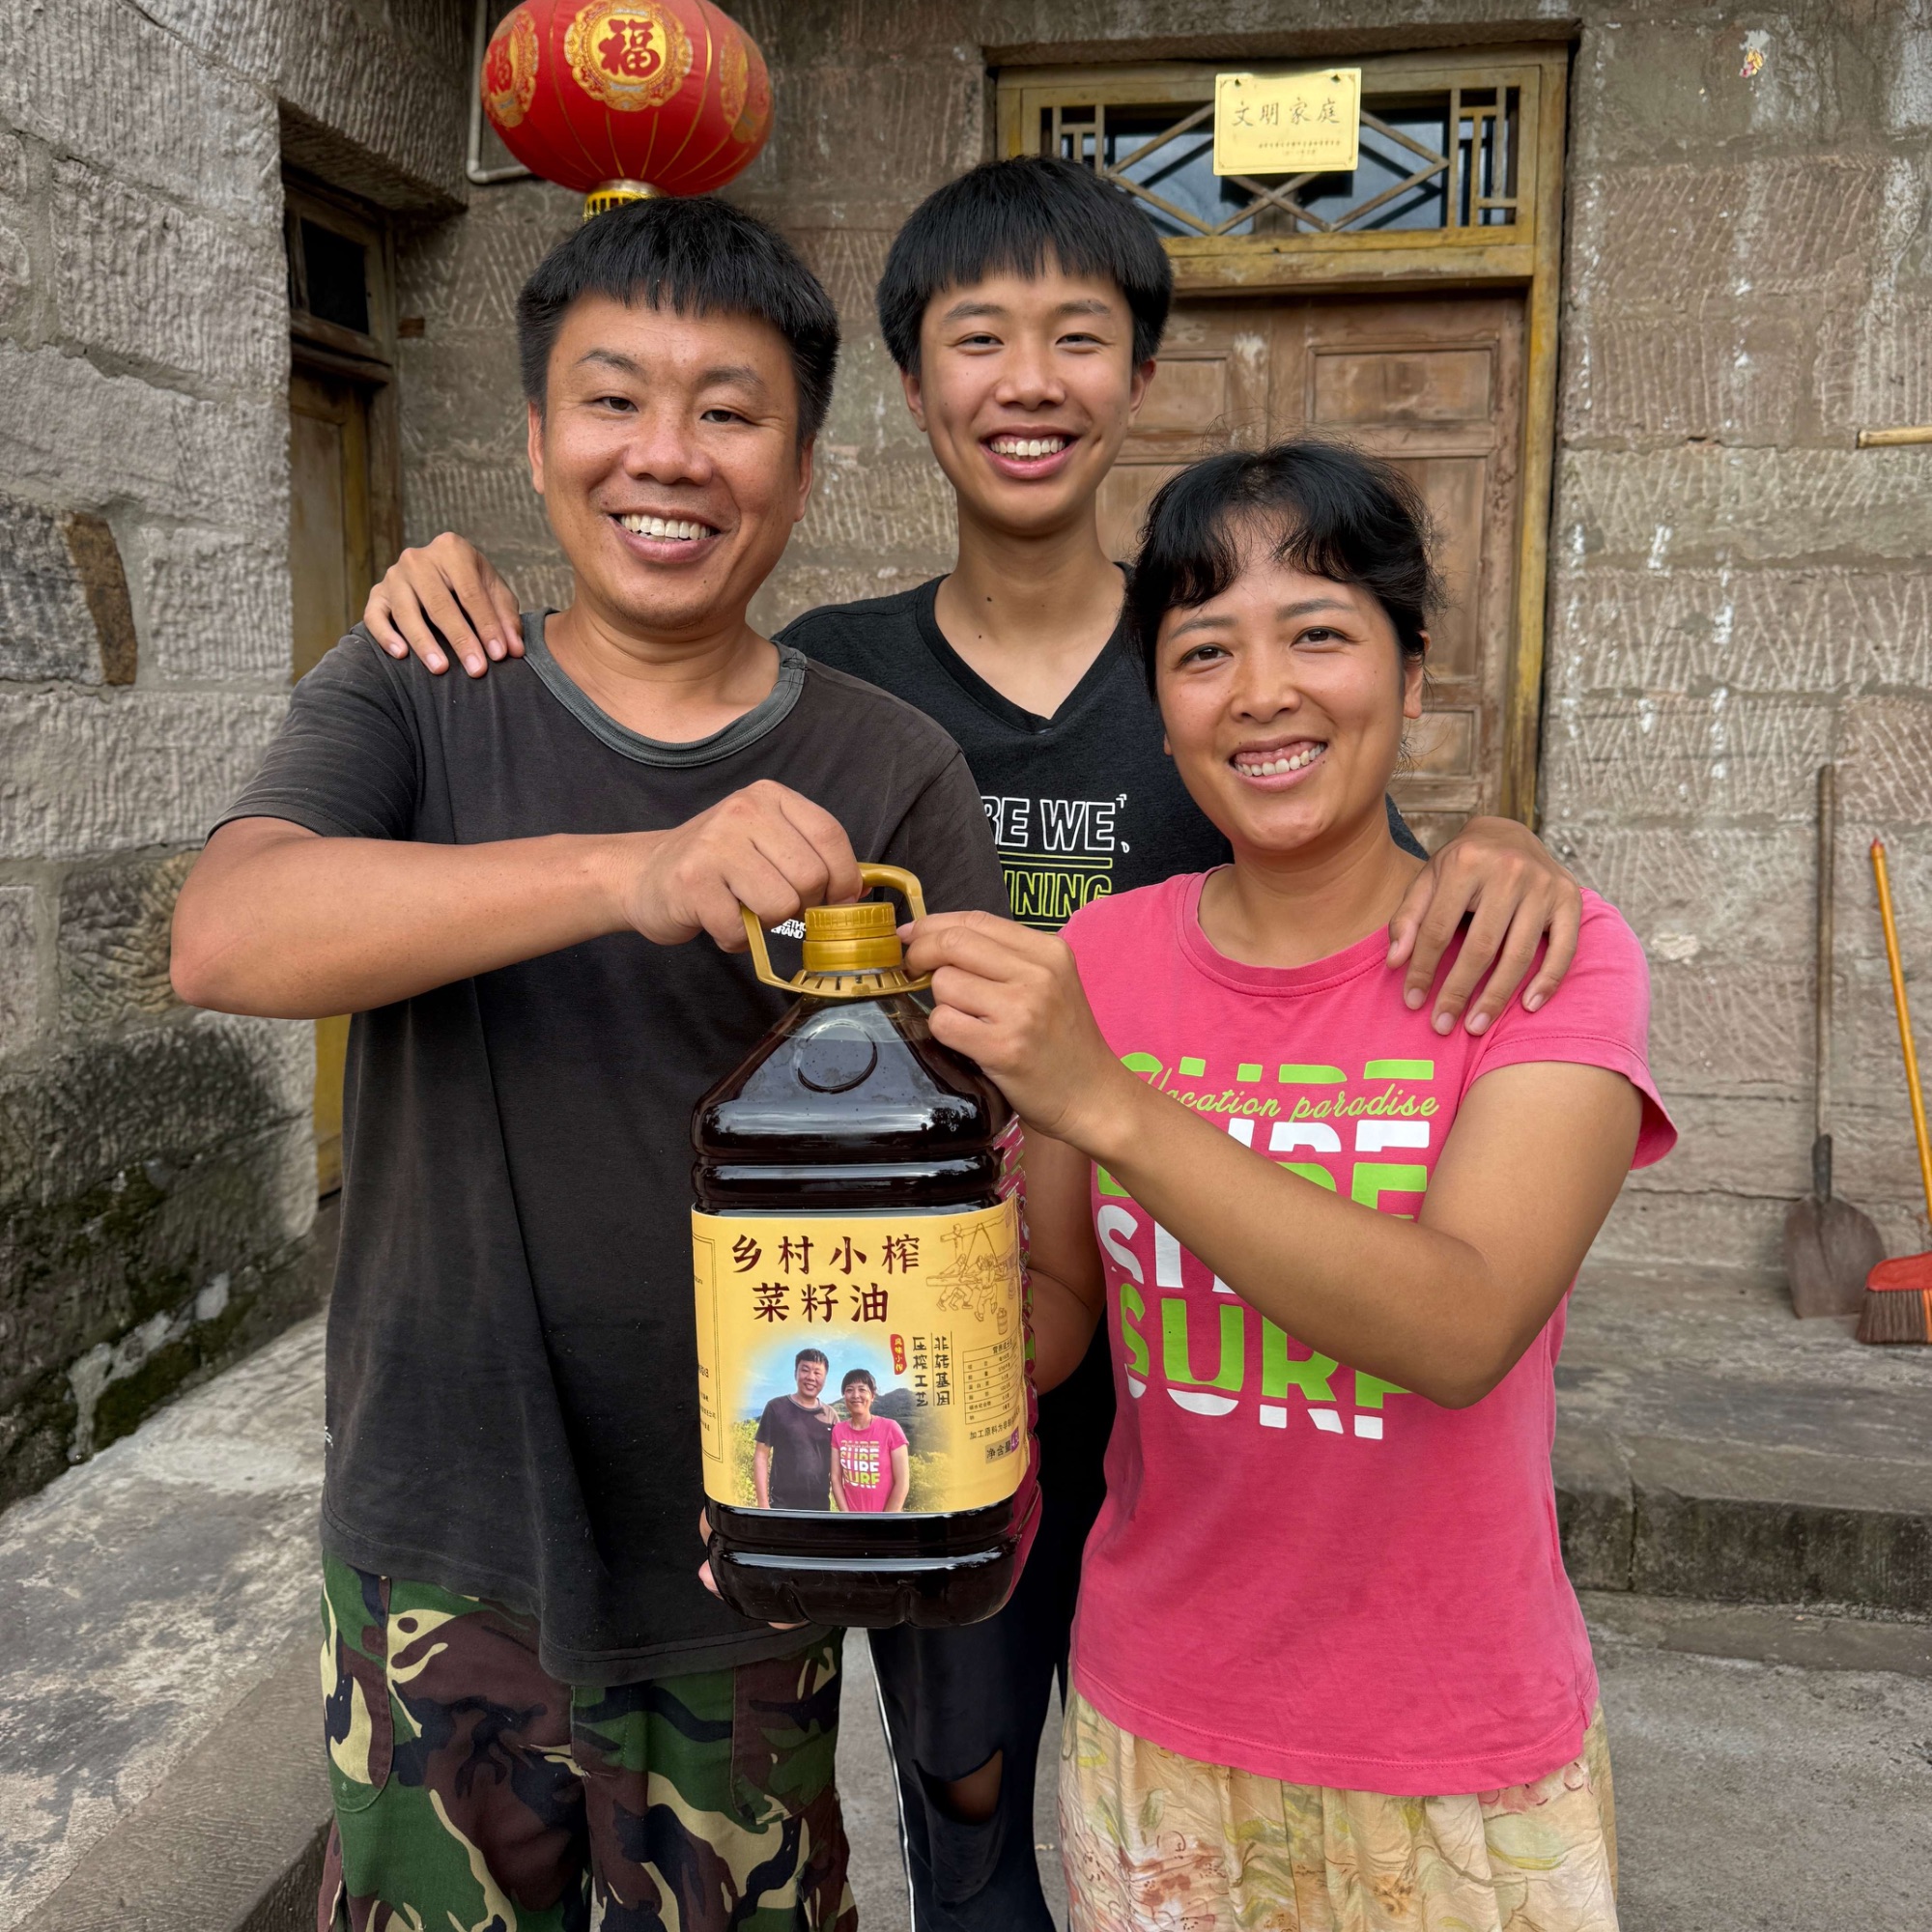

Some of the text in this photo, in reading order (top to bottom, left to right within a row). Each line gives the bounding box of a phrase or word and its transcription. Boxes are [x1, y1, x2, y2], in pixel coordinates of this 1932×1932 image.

[598, 18, 662, 78] 福
[1232, 97, 1341, 128] 文明家庭
[1290, 1083, 1440, 1122] paradise
[731, 1234, 921, 1275] 乡村小榨
[752, 1282, 890, 1323] 菜籽油
[912, 1336, 928, 1407] 压榨工艺
[934, 1335, 951, 1406] 非转基因
[986, 1439, 1011, 1460] 净含量
